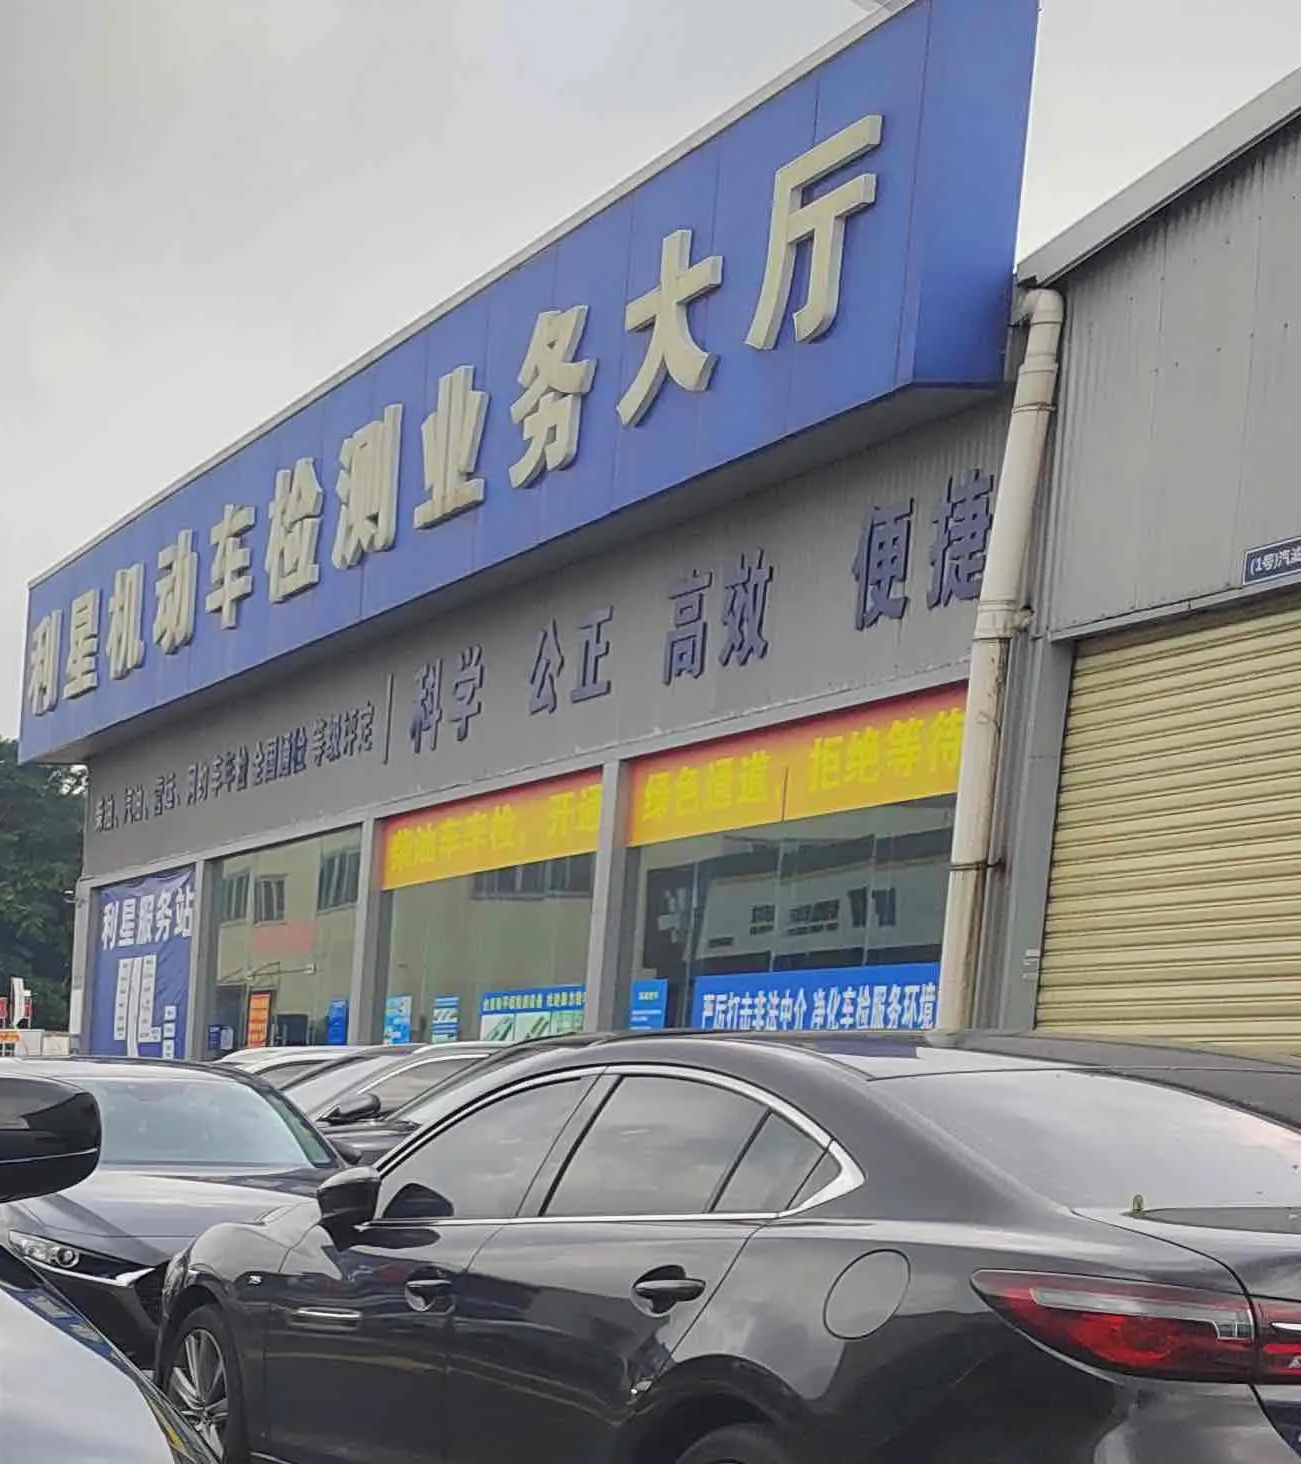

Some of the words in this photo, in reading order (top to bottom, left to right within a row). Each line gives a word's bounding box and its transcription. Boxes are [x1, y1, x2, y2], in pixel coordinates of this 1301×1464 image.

[28, 114, 883, 716] 利星机动车检测业务大厅
[410, 644, 484, 753] 科学
[528, 605, 614, 716] 公正
[662, 546, 773, 686] 高效
[852, 468, 995, 632] 便捷
[101, 885, 195, 951] 利星服务站
